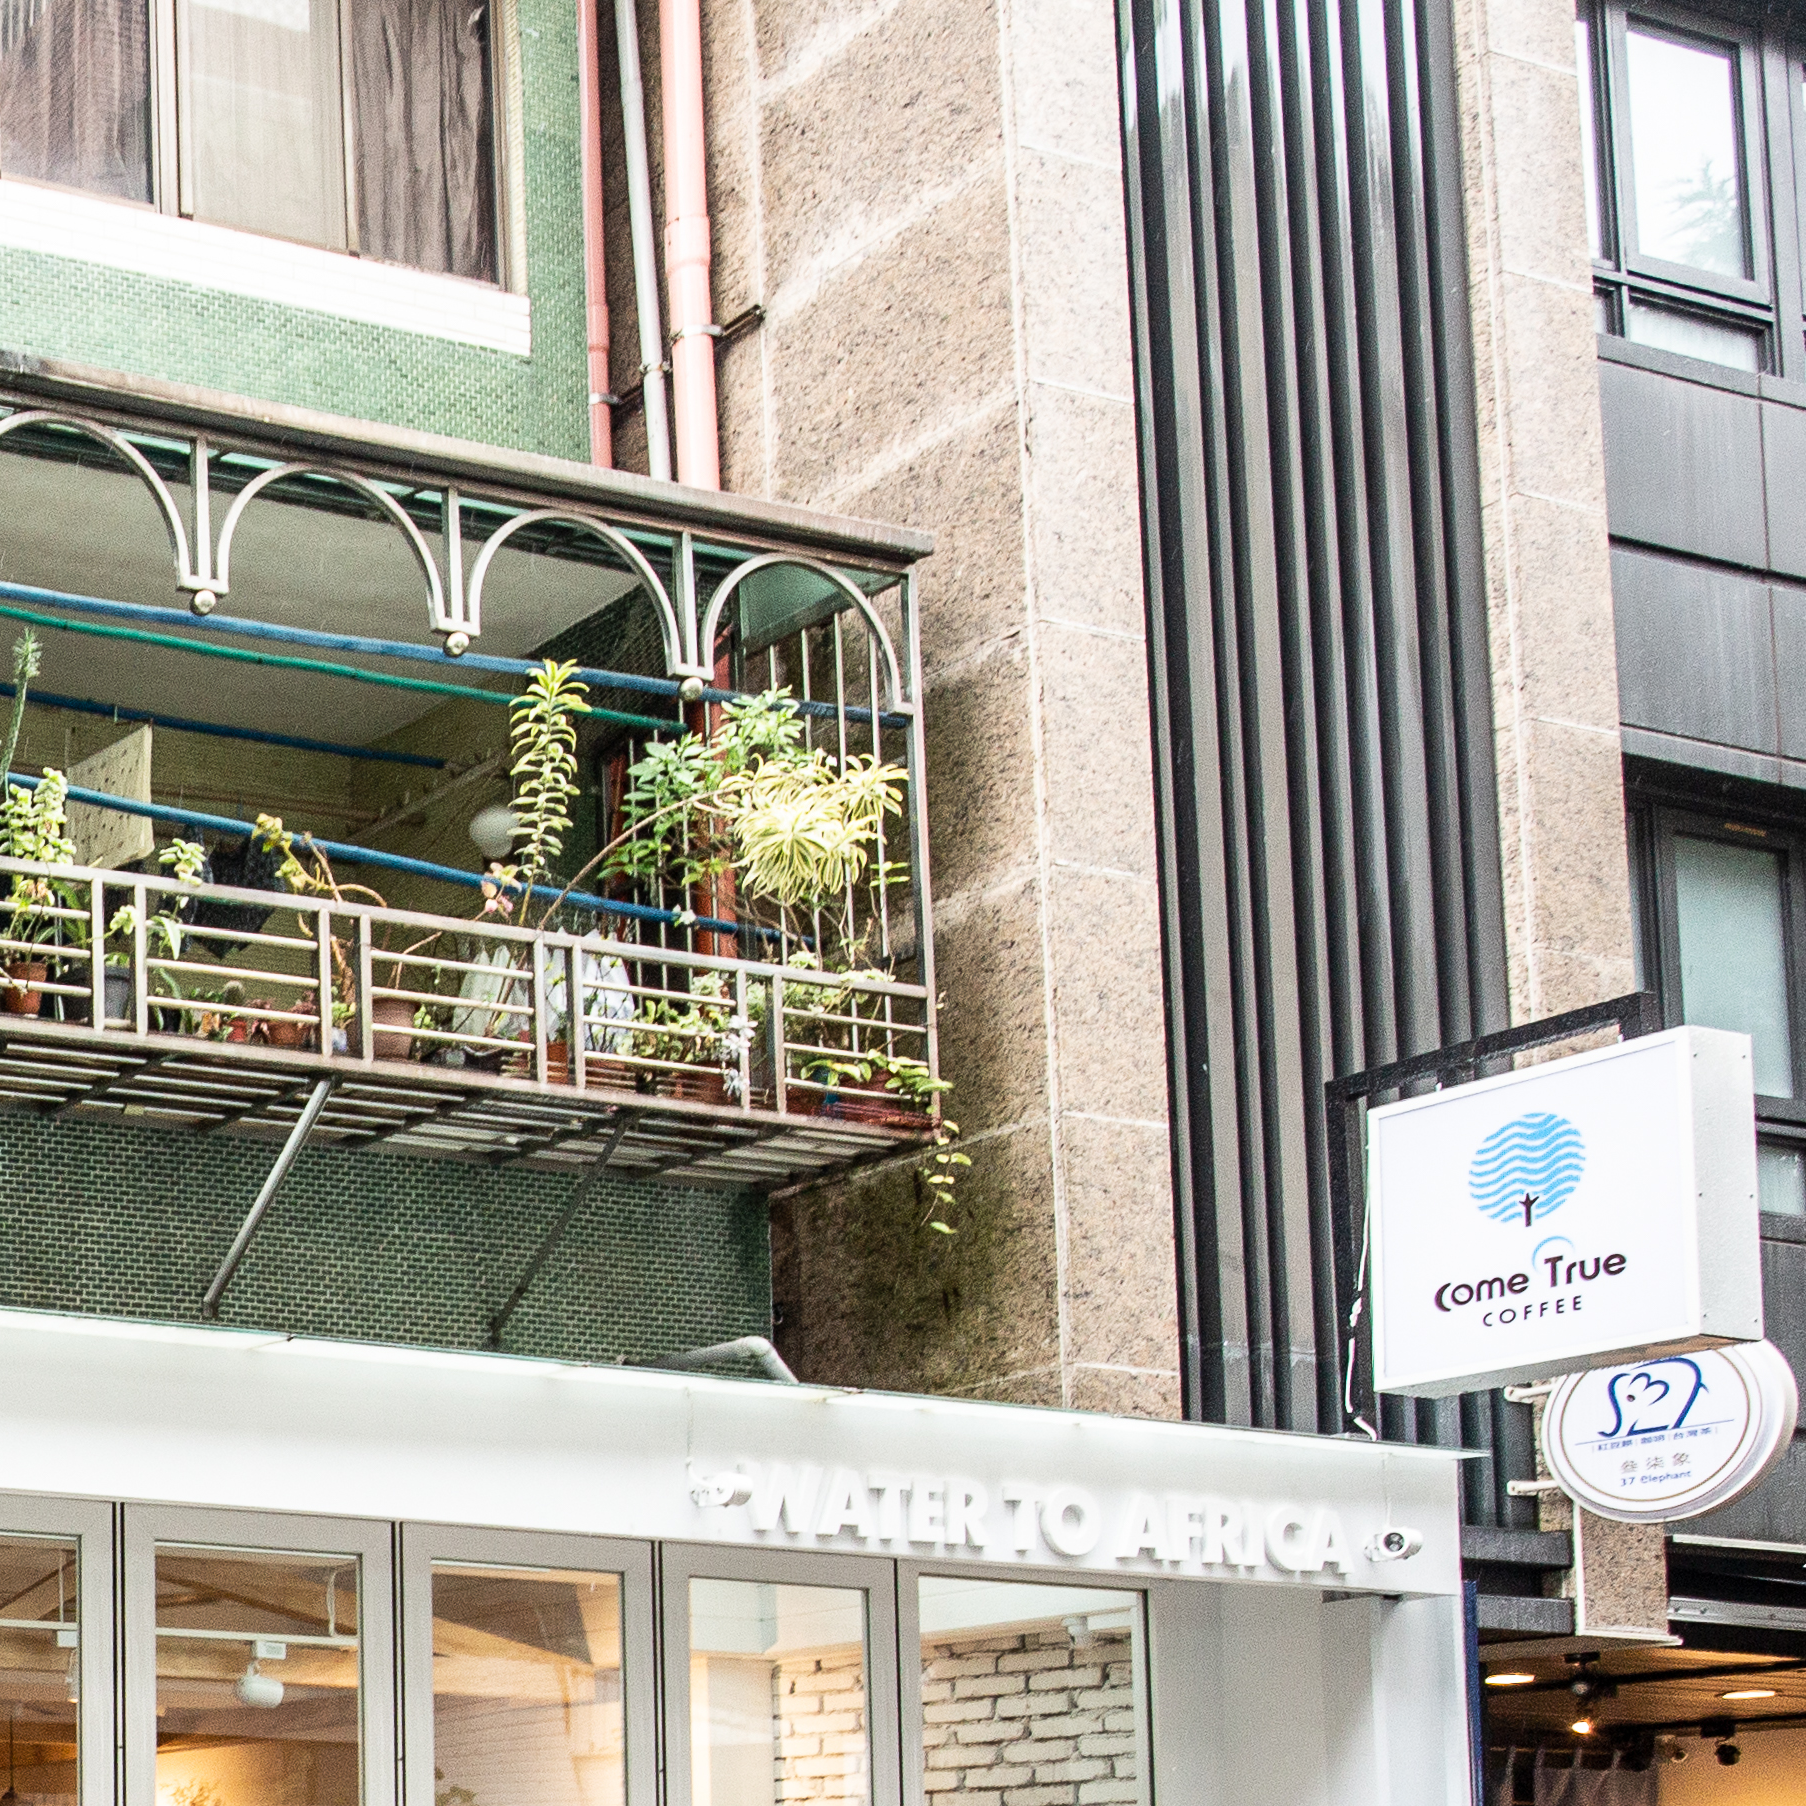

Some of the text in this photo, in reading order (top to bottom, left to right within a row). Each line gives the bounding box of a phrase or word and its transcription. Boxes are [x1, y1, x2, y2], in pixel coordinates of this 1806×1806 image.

[1434, 1254, 1627, 1313] Come True
[1483, 1294, 1582, 1327] COFFEE
[1620, 1476, 1636, 1487] 37
[749, 1464, 1356, 1576] WATER TO AFRICA
